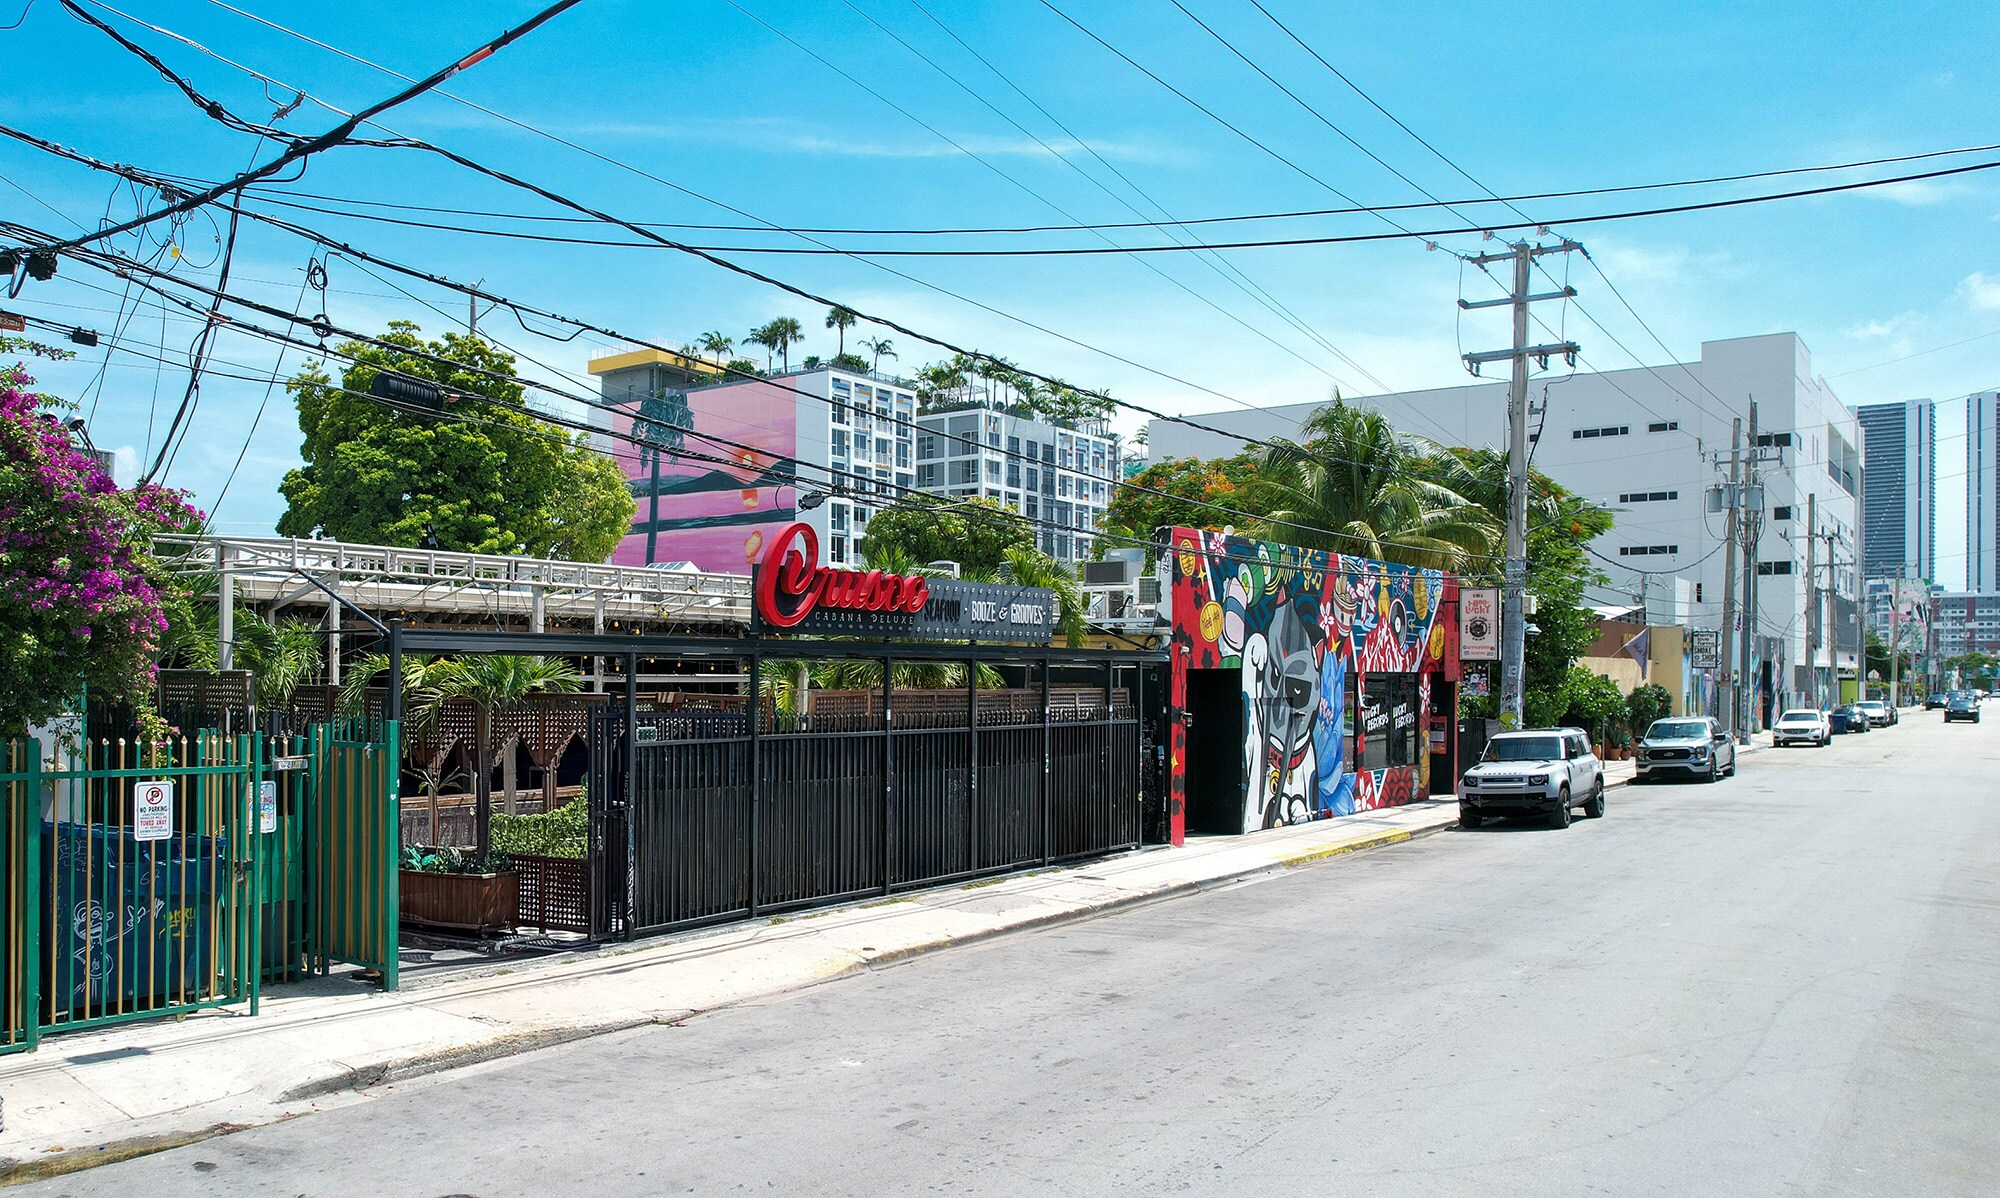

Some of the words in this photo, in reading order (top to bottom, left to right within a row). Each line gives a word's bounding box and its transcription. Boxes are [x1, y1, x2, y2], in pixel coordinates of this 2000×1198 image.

[756, 522, 930, 627] Crusoe
[815, 611, 862, 623] CABANA
[871, 613, 914, 625] DELUXE
[924, 599, 960, 622] SEAFOOD
[971, 600, 997, 623] BOOZE
[998, 606, 1008, 620] &
[1010, 603, 1043, 625] GROOVES
